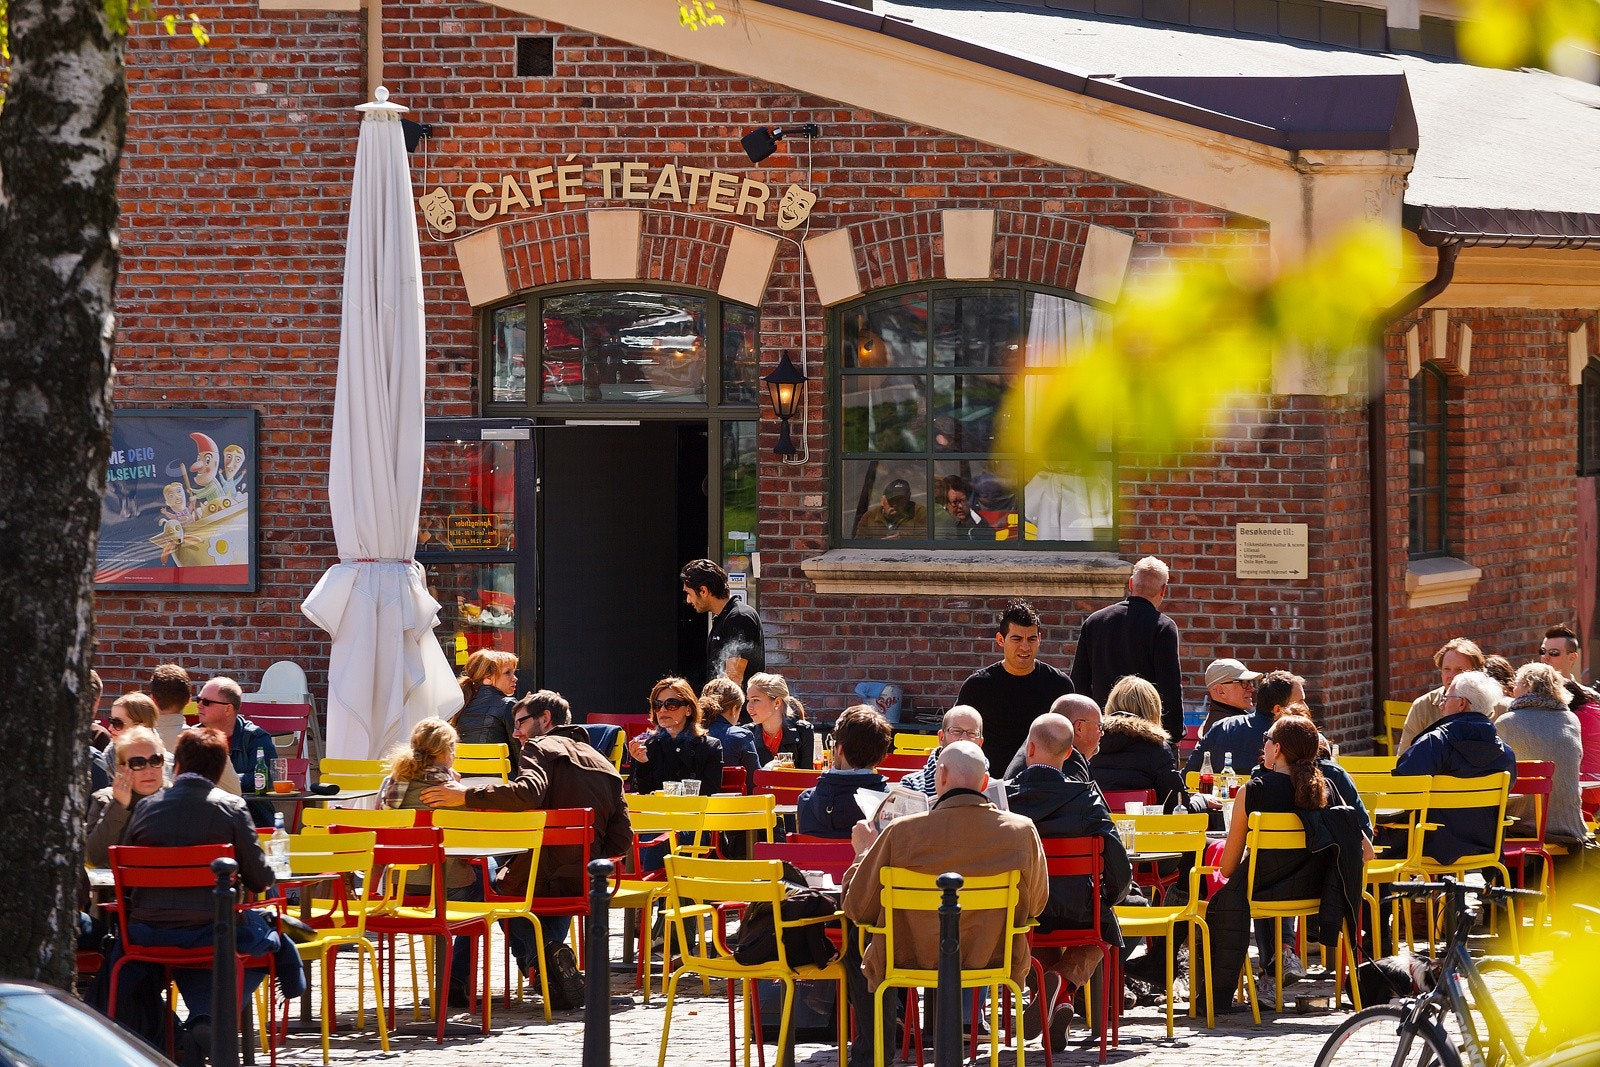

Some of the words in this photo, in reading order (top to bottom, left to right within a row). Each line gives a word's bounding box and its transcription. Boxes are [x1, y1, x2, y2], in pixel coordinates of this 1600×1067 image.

[465, 153, 586, 222] CAFÉ
[592, 161, 771, 222] TEATER
[128, 447, 154, 462] DEIG
[1240, 528, 1281, 536] Besøkende
[1283, 528, 1294, 536] til:
